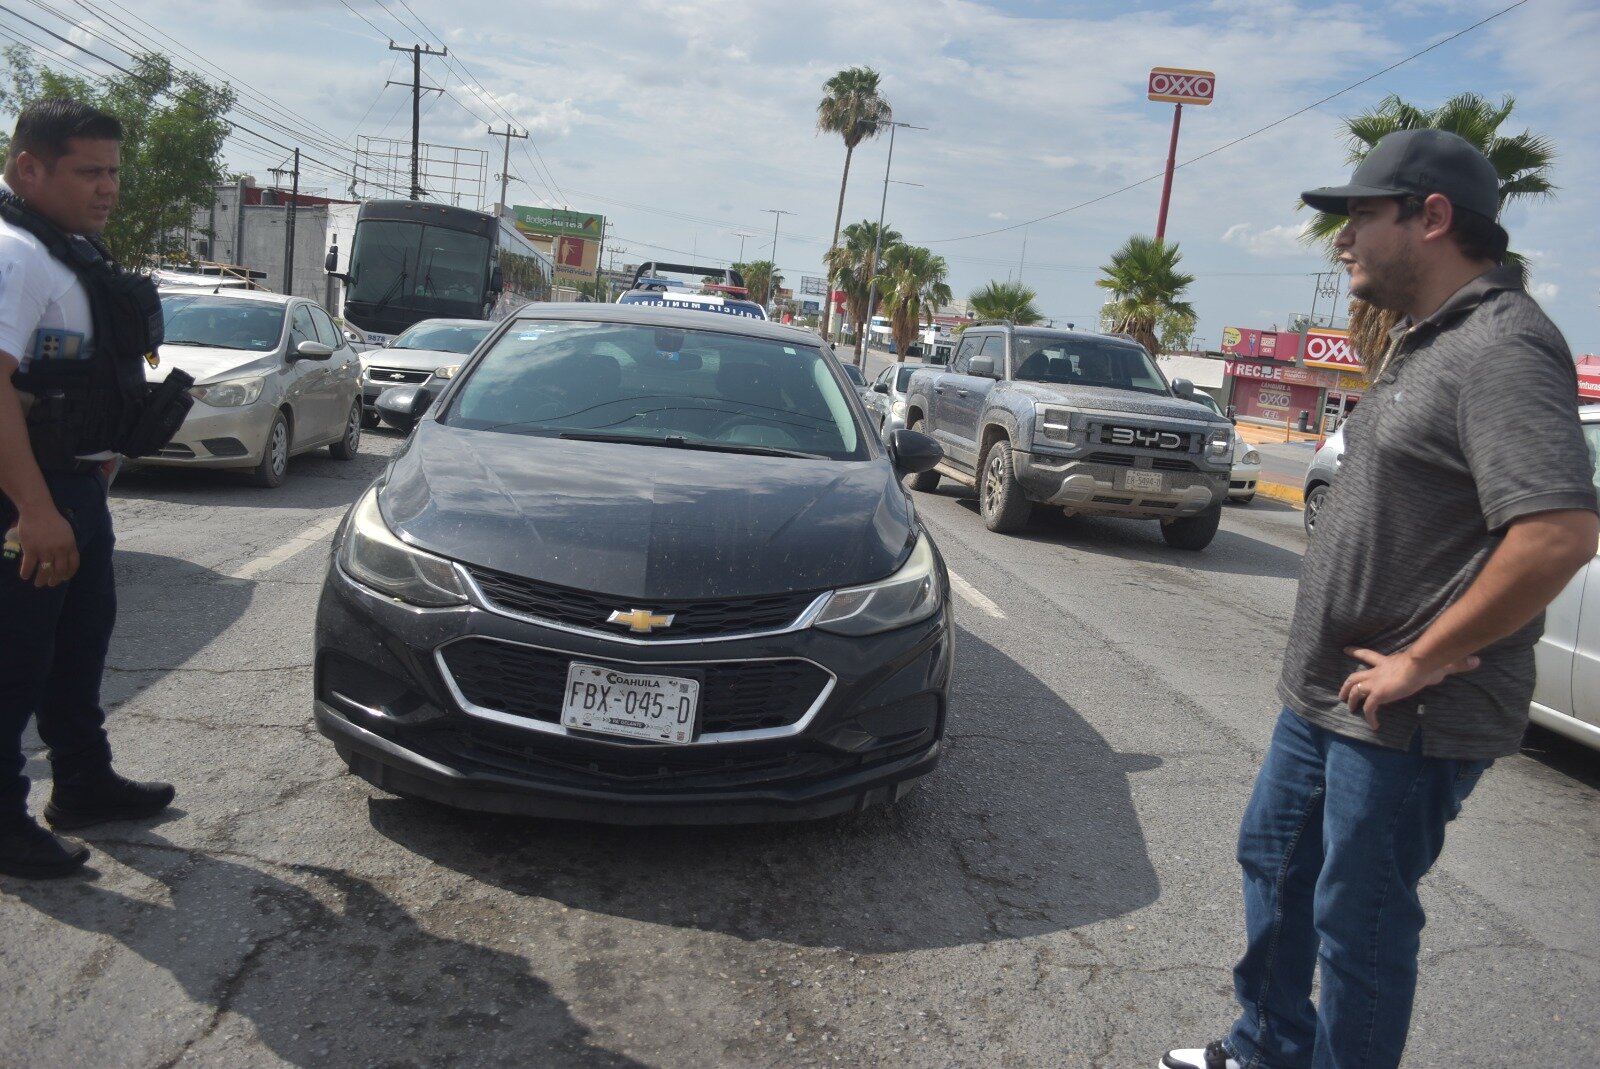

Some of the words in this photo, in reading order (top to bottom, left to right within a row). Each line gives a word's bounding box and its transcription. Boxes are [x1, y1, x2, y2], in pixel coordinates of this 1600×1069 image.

[1151, 75, 1212, 97] OXXO
[1307, 337, 1361, 363] OXX
[1225, 362, 1234, 374] Y
[1236, 363, 1282, 380] RECE
[1259, 392, 1290, 407] OXXO
[1263, 410, 1279, 419] CEL
[1111, 427, 1181, 449] BYD
[570, 681, 690, 724] FBX-045-D
